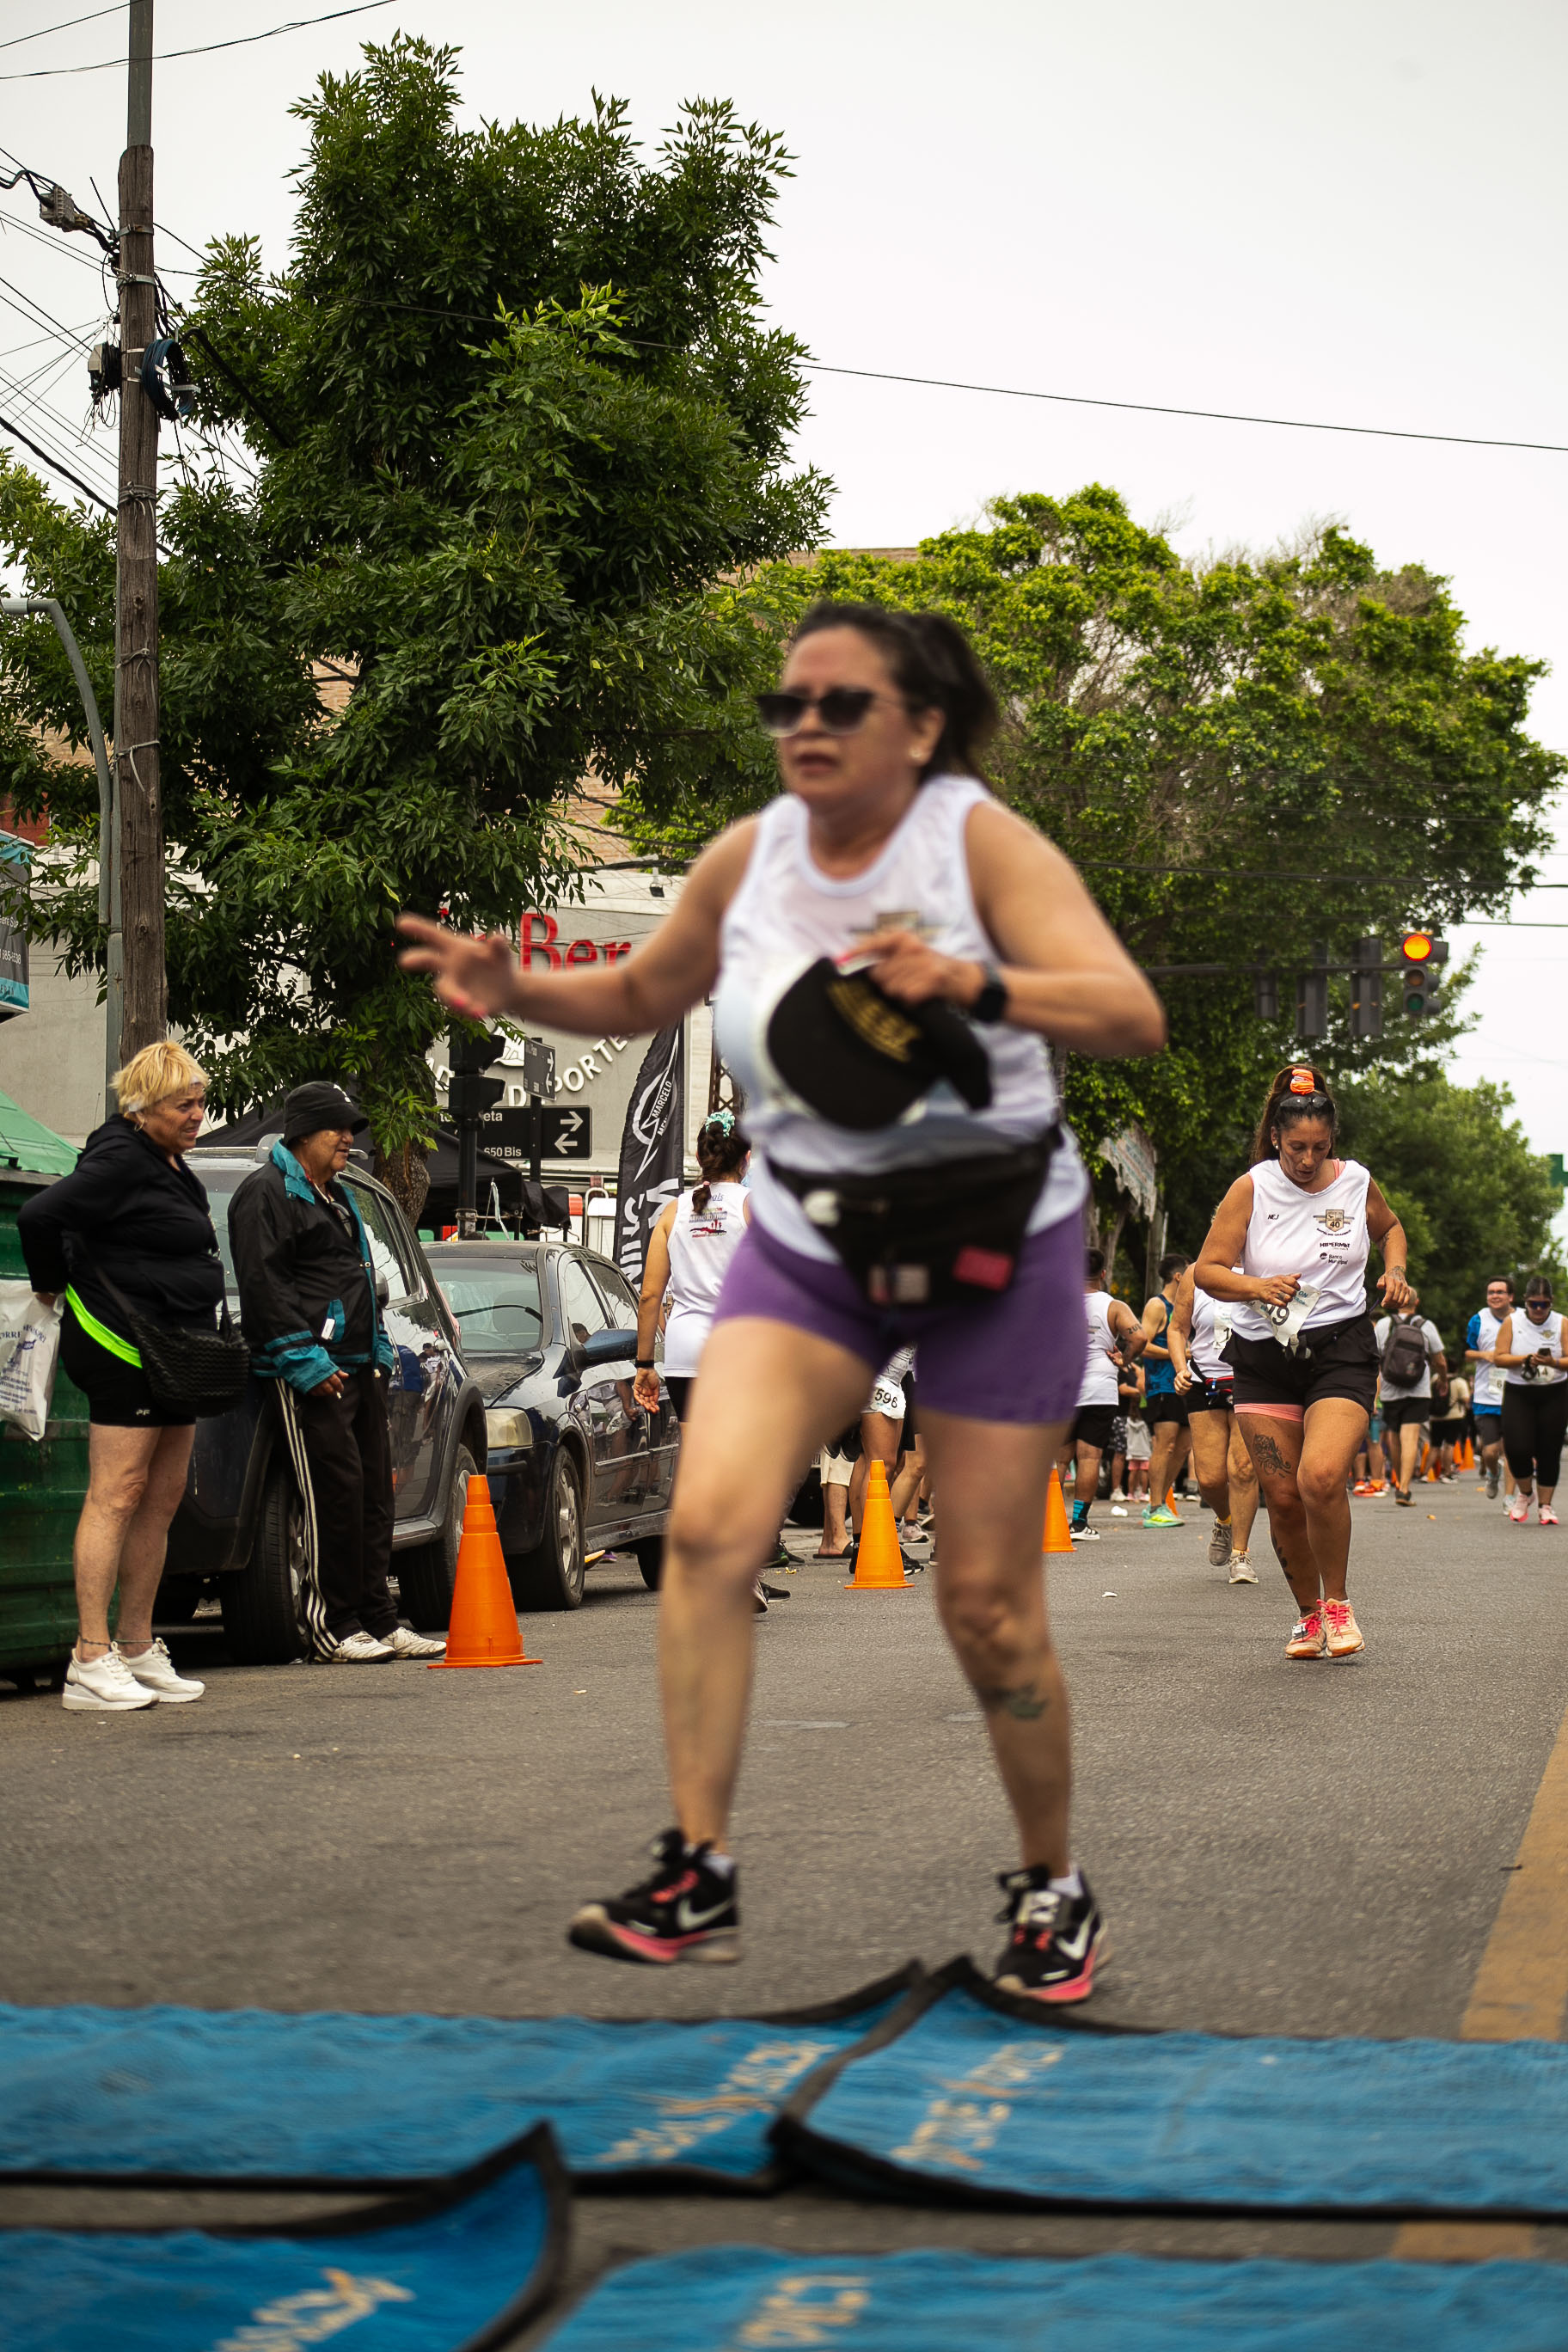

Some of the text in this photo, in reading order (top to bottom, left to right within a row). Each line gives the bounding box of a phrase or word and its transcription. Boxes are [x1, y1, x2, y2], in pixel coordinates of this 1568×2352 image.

[652, 1081, 672, 1118] MARCELO
[504, 1147, 522, 1157] Bis
[874, 1388, 898, 1408] 596
